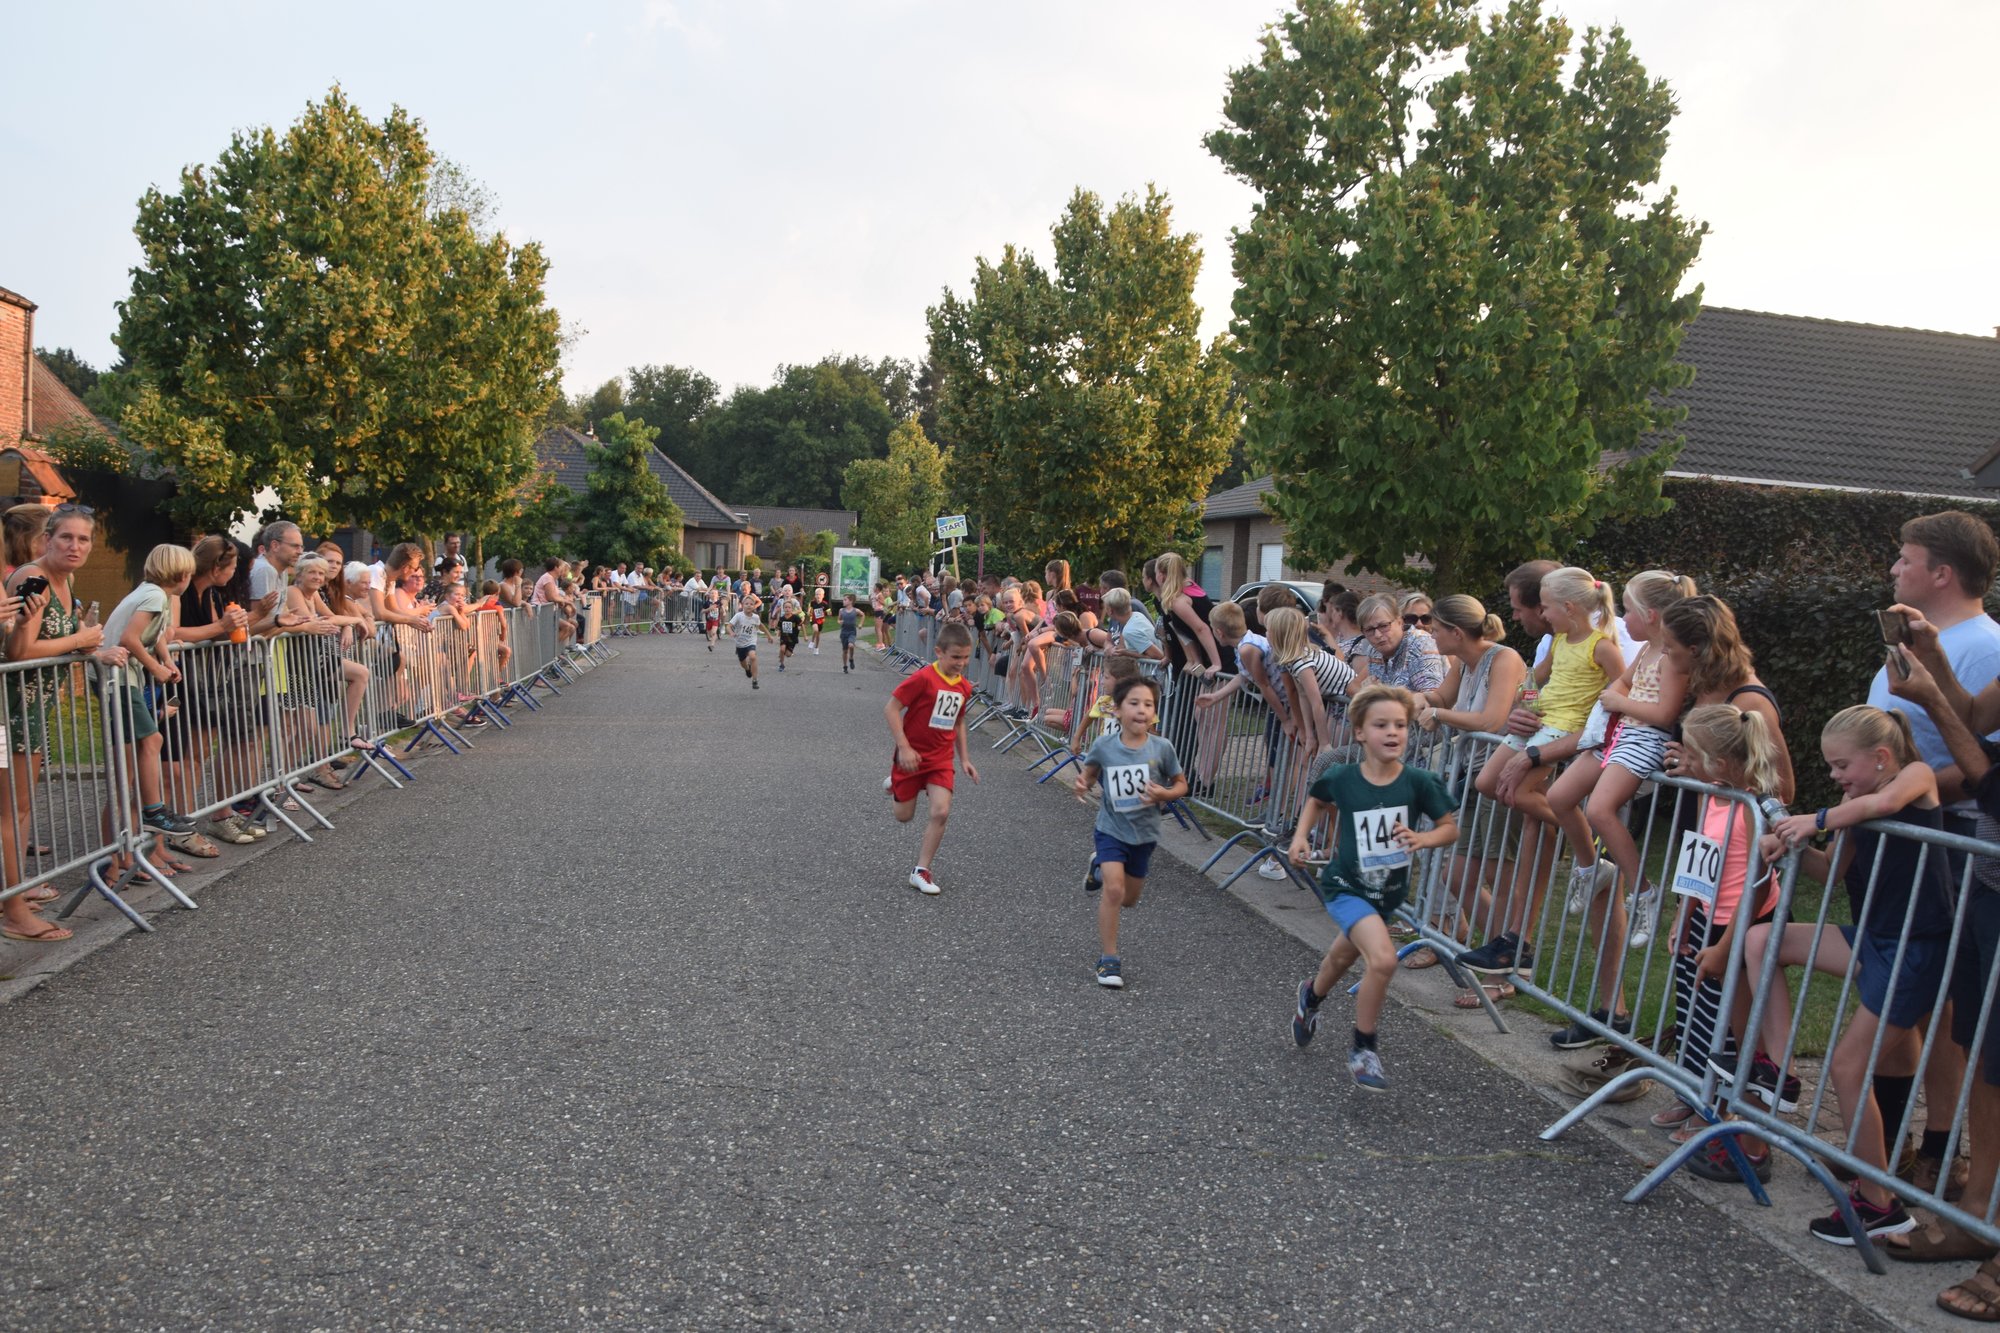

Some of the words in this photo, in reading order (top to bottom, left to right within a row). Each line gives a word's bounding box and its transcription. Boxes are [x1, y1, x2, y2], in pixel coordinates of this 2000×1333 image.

[939, 520, 965, 533] START
[938, 694, 959, 717] 125
[1106, 722, 1121, 735] 12
[1112, 768, 1146, 797] 133
[1686, 838, 1720, 883] 170
